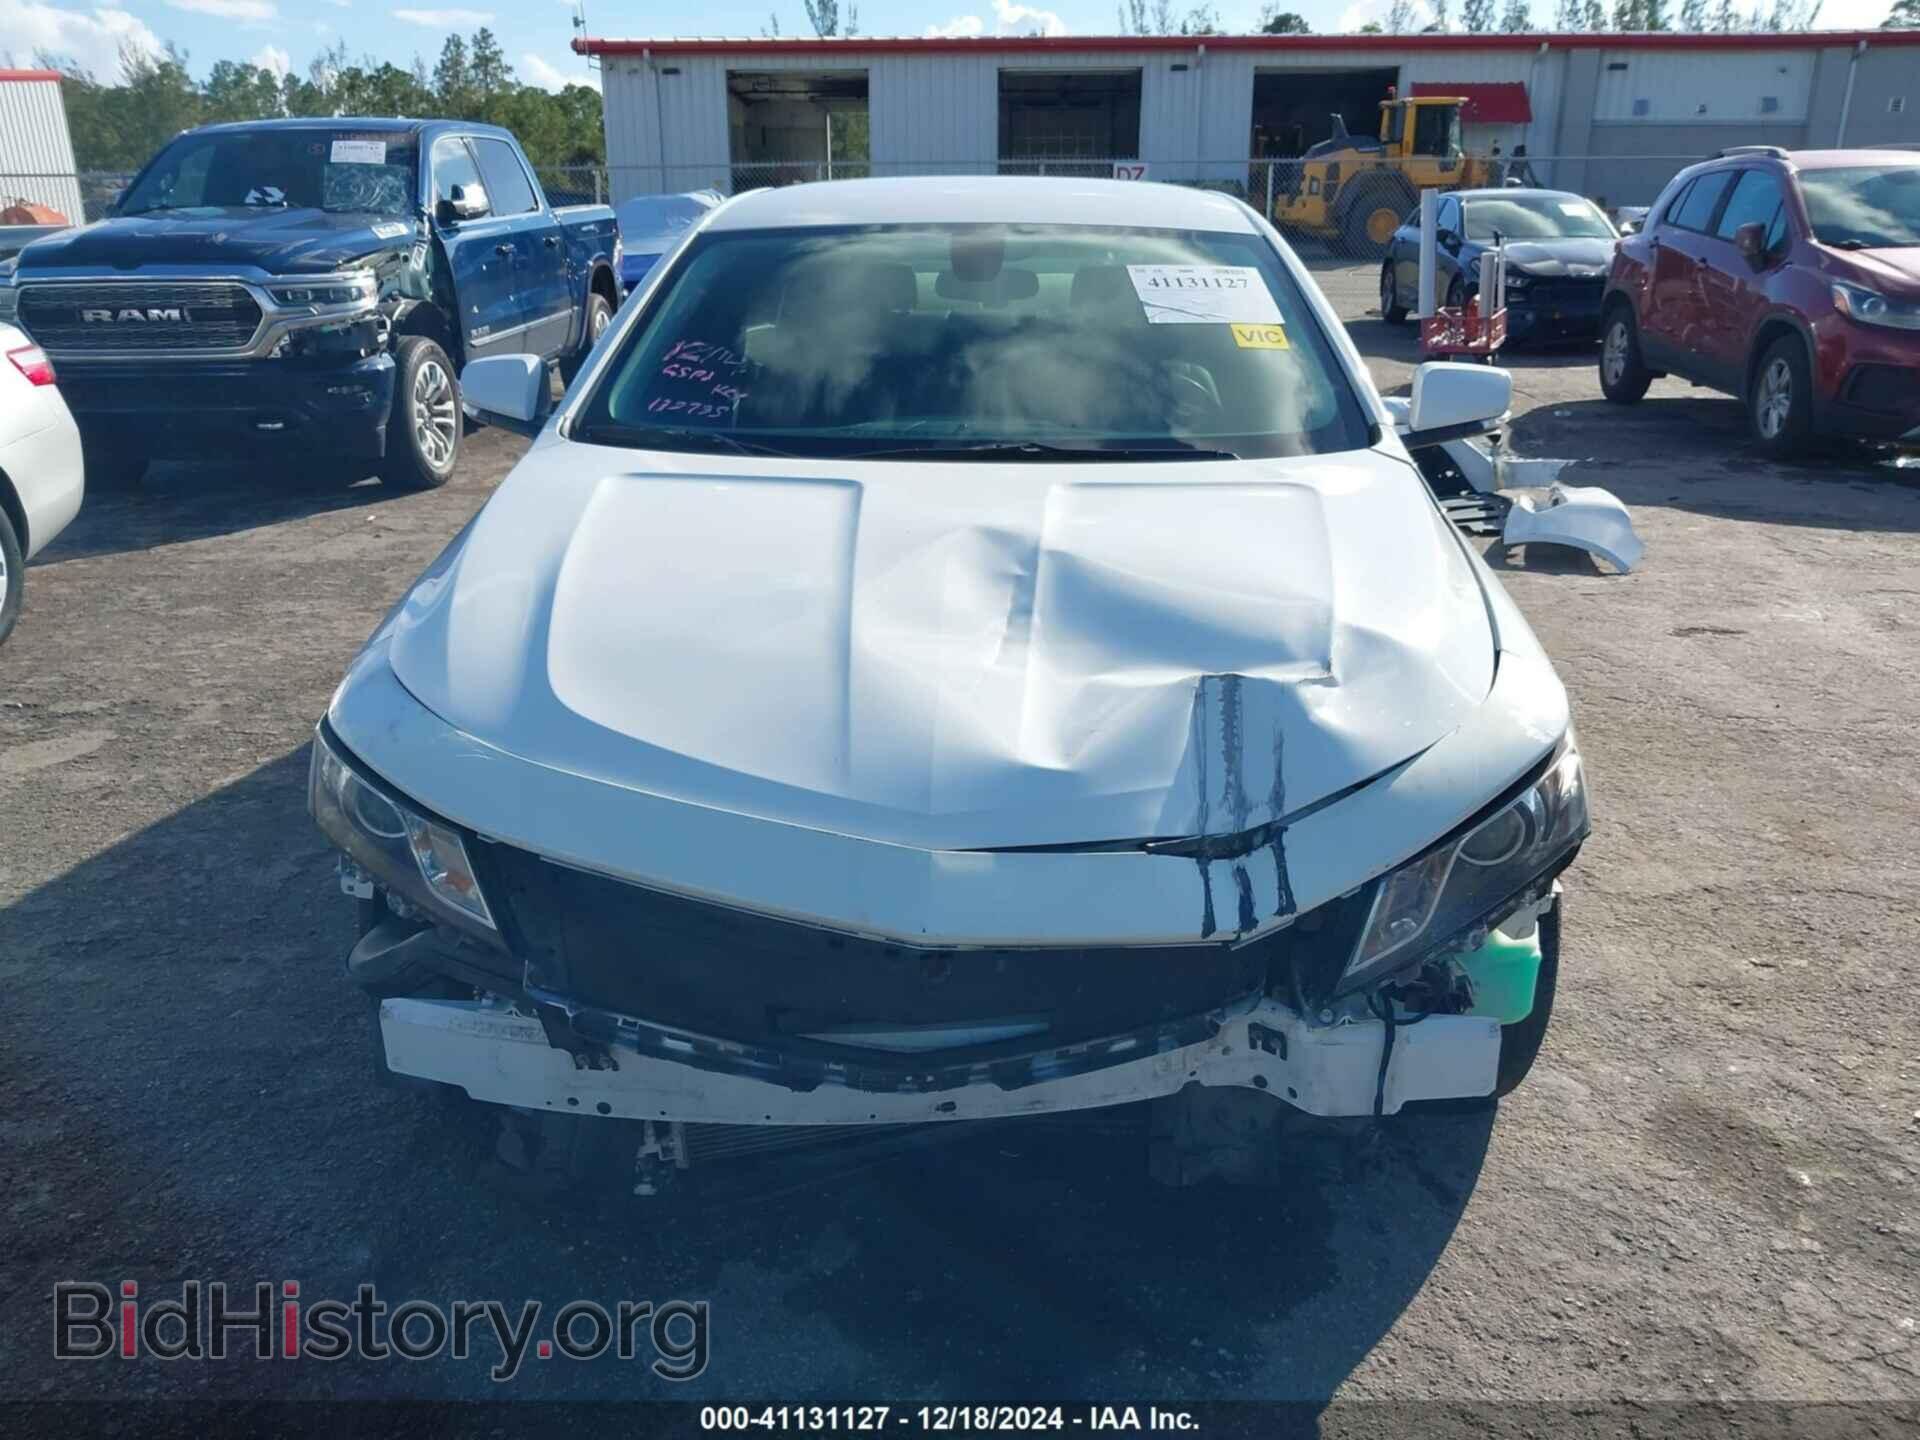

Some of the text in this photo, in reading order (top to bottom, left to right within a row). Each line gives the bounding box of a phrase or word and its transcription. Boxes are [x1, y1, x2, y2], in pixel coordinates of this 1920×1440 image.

[1147, 277, 1248, 289] 41131127
[82, 309, 181, 321] RAM
[1237, 329, 1282, 344] VIC
